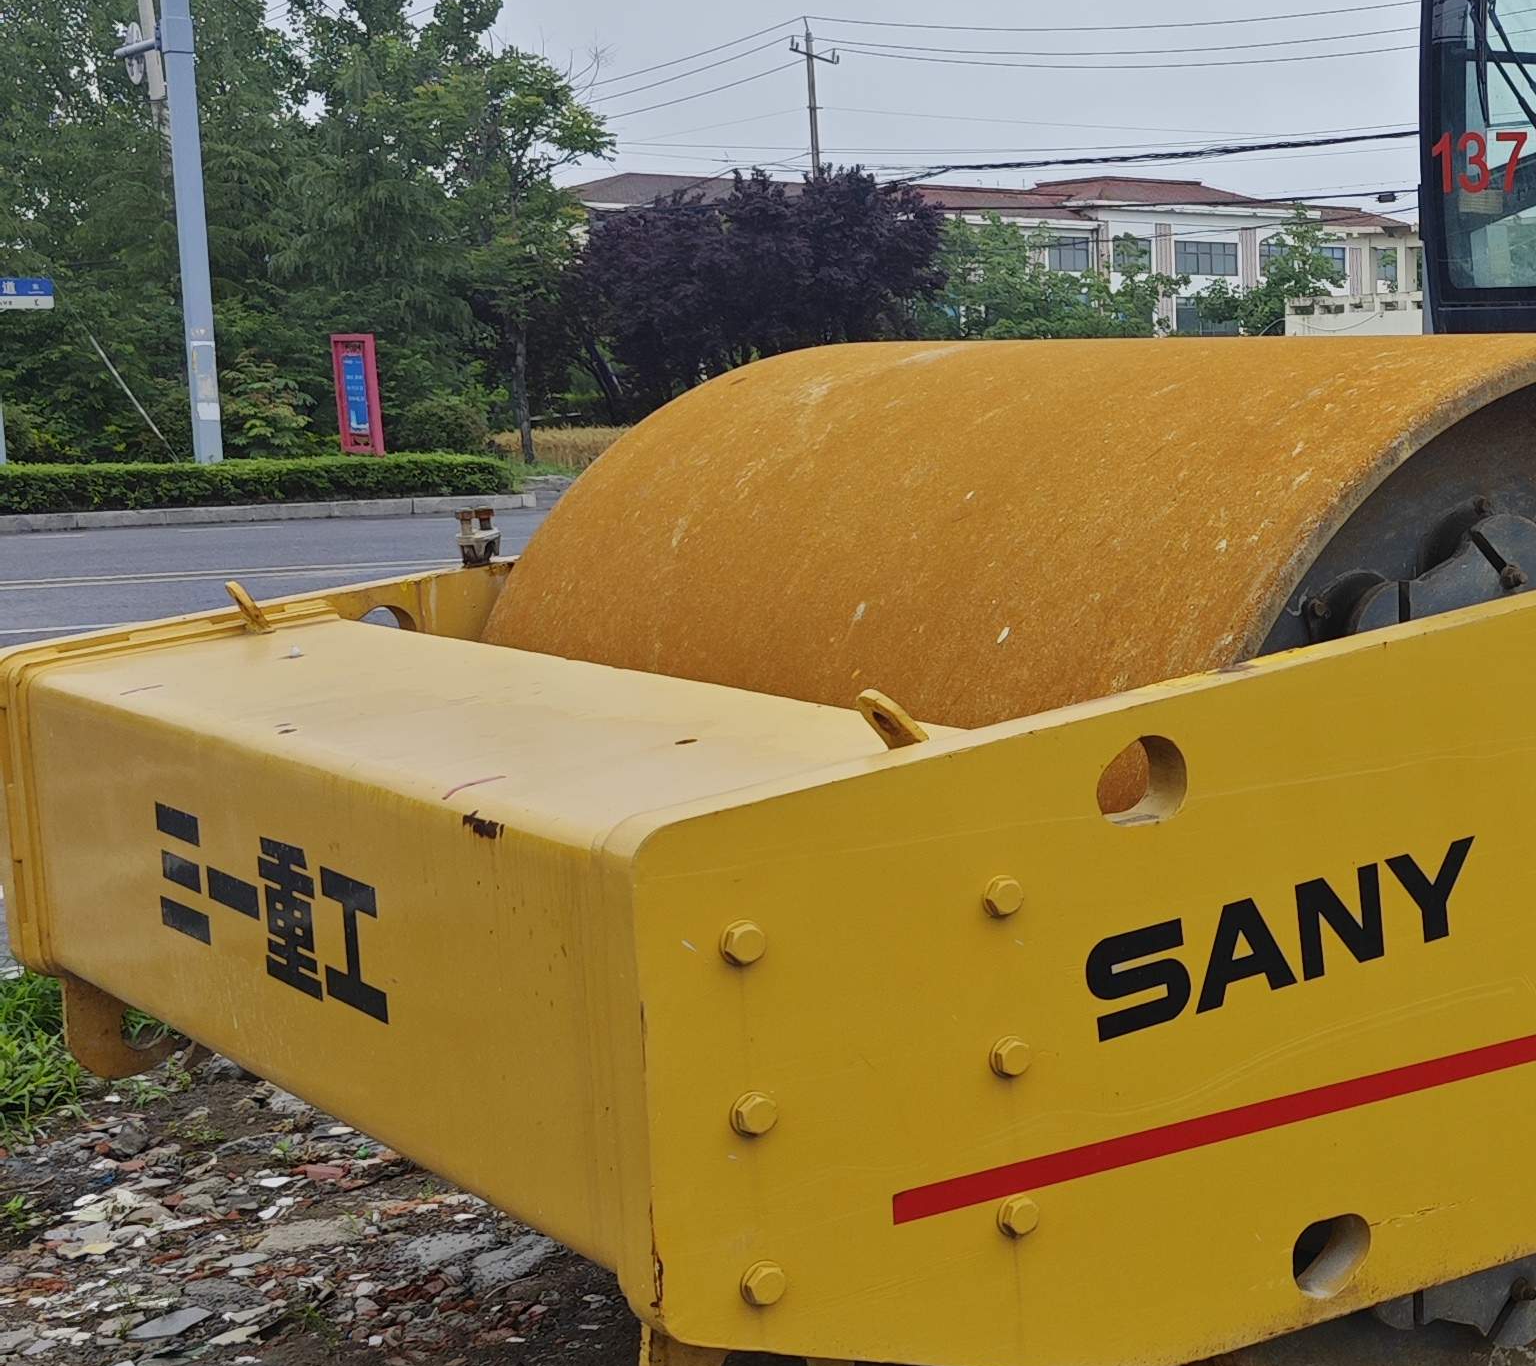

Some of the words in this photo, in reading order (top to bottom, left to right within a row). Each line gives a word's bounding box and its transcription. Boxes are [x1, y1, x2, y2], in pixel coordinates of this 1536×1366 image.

[155, 801, 389, 1024] 三一重工
[1085, 835, 1475, 1043] SANY
